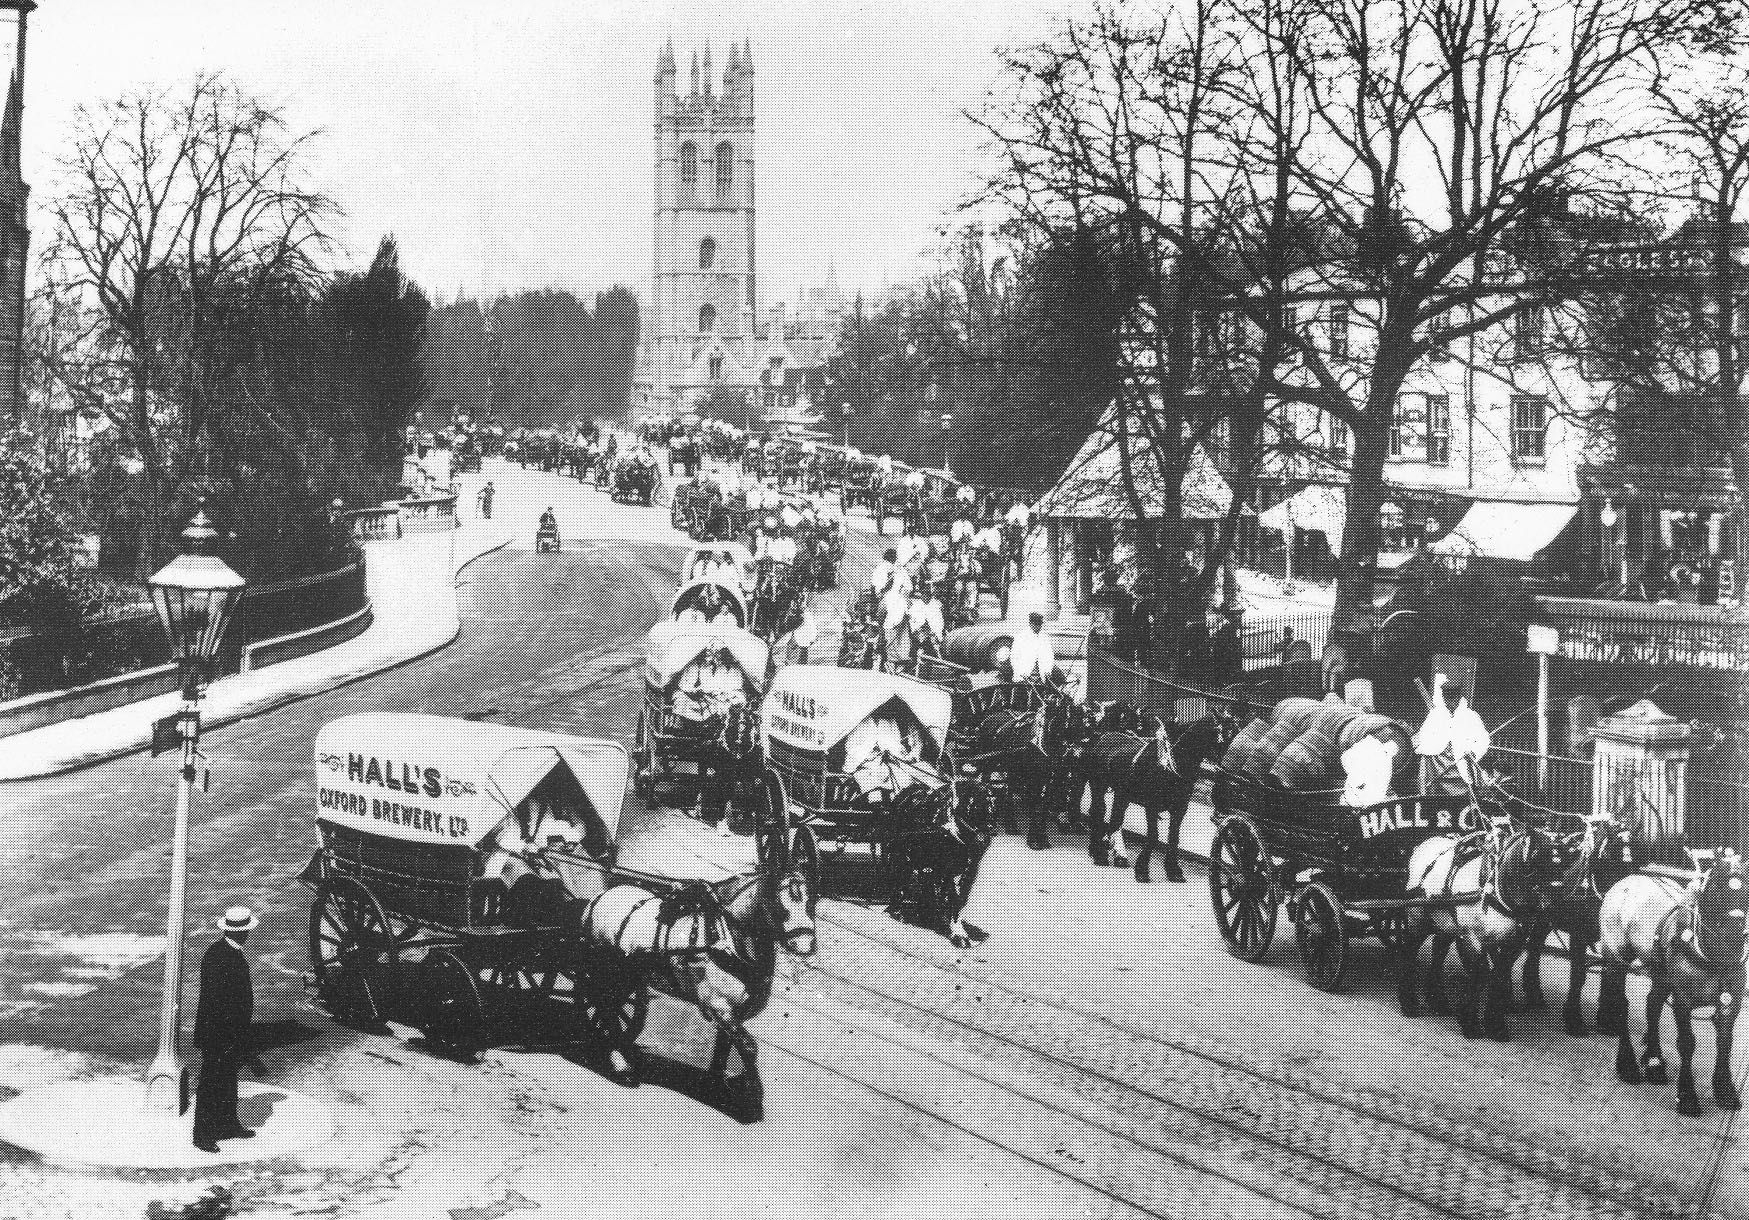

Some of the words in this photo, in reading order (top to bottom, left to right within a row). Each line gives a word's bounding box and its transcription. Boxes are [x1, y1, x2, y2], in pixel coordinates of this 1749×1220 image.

[348, 752, 442, 798] HALL'S
[320, 787, 367, 816] OXFORD
[1359, 802, 1429, 839] HALL
[1436, 810, 1452, 828] &
